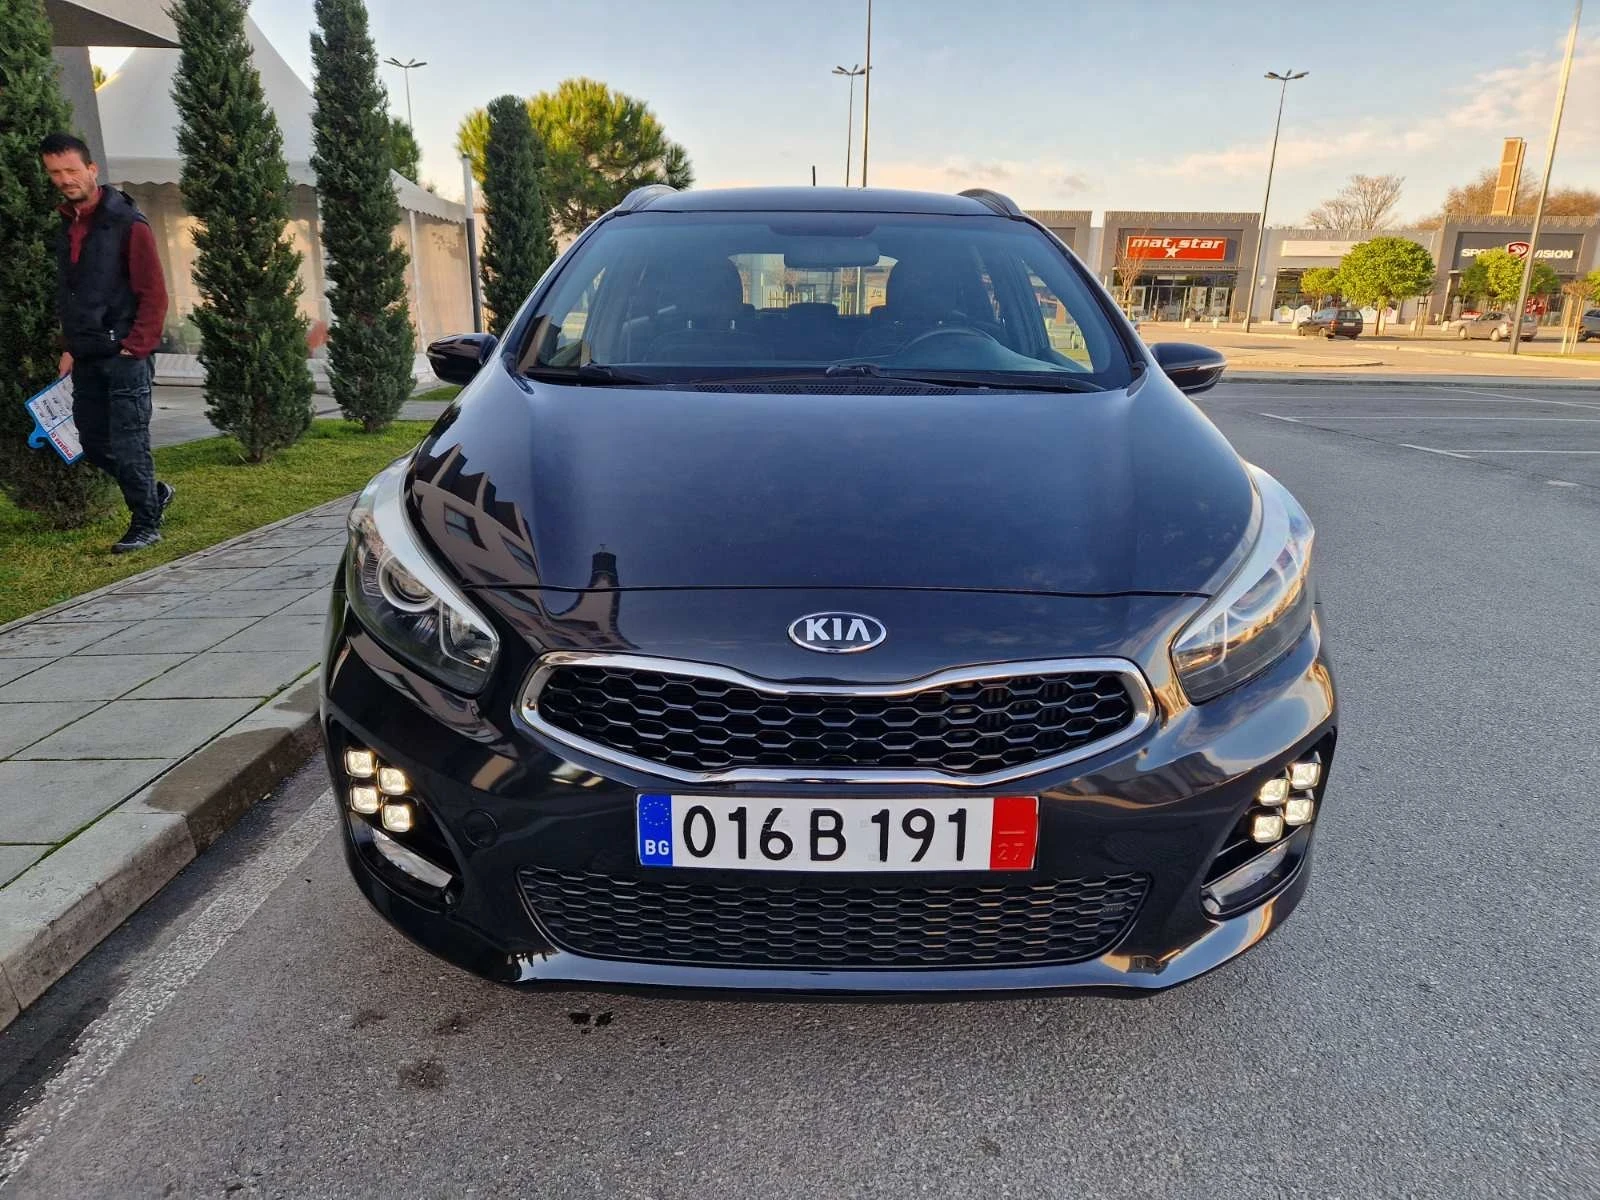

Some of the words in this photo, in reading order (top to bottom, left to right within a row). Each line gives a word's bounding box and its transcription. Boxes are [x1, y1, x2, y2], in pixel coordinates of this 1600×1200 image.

[1131, 237, 1172, 248] mat
[1178, 238, 1223, 249] star
[805, 617, 871, 642] KIA
[682, 804, 794, 861] 016
[809, 808, 847, 862] B
[870, 808, 967, 863] 191
[645, 839, 670, 856] BG
[998, 842, 1025, 861] 27
